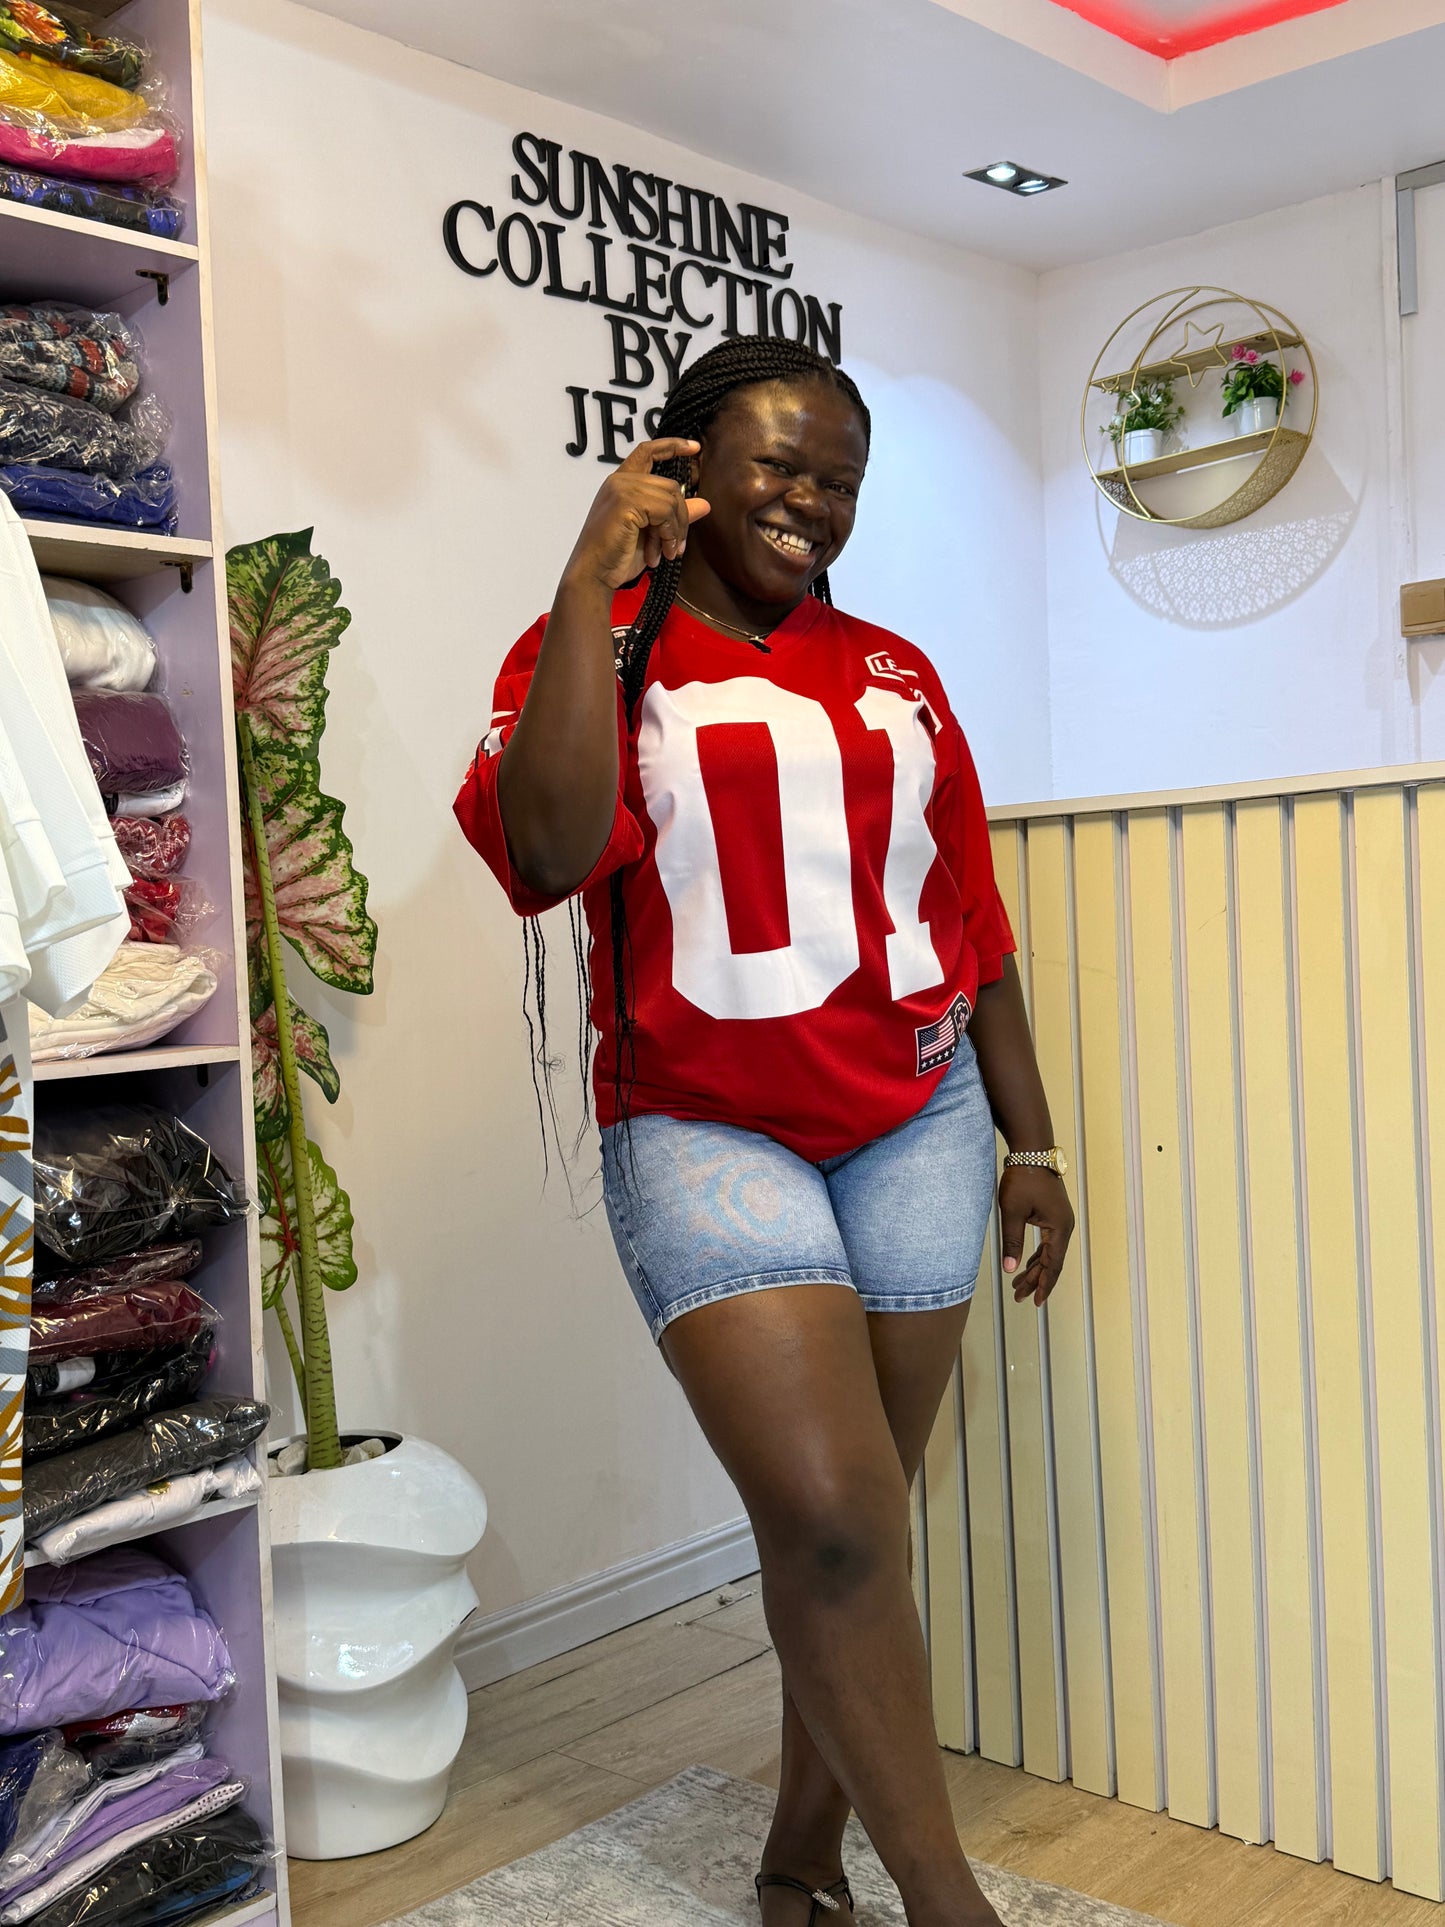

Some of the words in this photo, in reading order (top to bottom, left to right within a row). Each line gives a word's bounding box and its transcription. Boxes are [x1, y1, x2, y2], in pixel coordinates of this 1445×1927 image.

[442, 199, 843, 366] COLLECTION
[511, 131, 794, 279] SUNSHINE
[604, 313, 692, 398] BY
[637, 675, 946, 1021] 01
